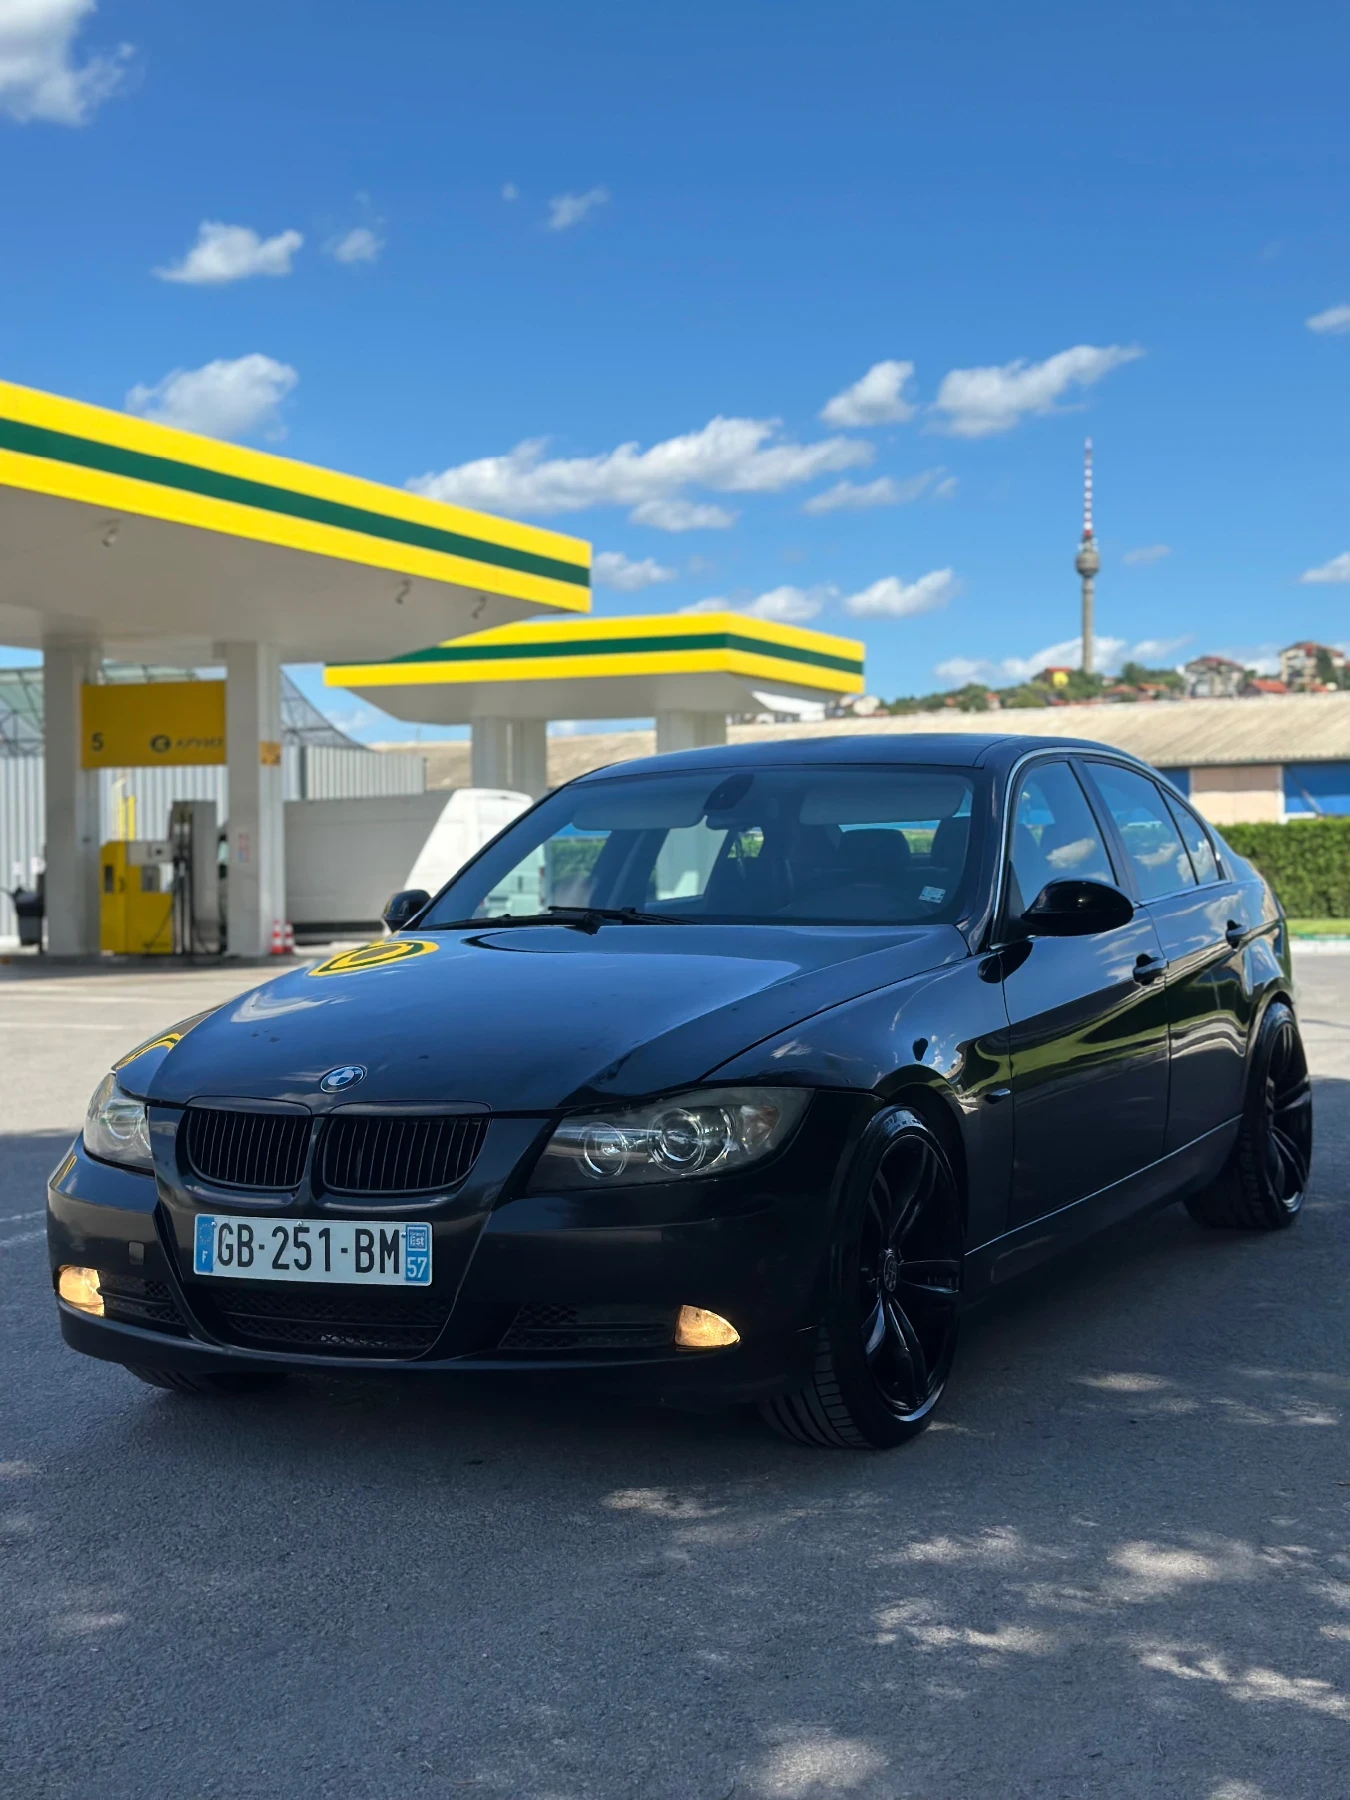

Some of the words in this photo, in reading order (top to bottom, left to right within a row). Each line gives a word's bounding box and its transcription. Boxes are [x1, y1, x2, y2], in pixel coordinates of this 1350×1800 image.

[92, 732, 104, 751] 5
[217, 1223, 400, 1274] GB-251-BM
[409, 1236, 425, 1246] Est
[202, 1250, 208, 1263] F
[407, 1257, 428, 1278] 57
